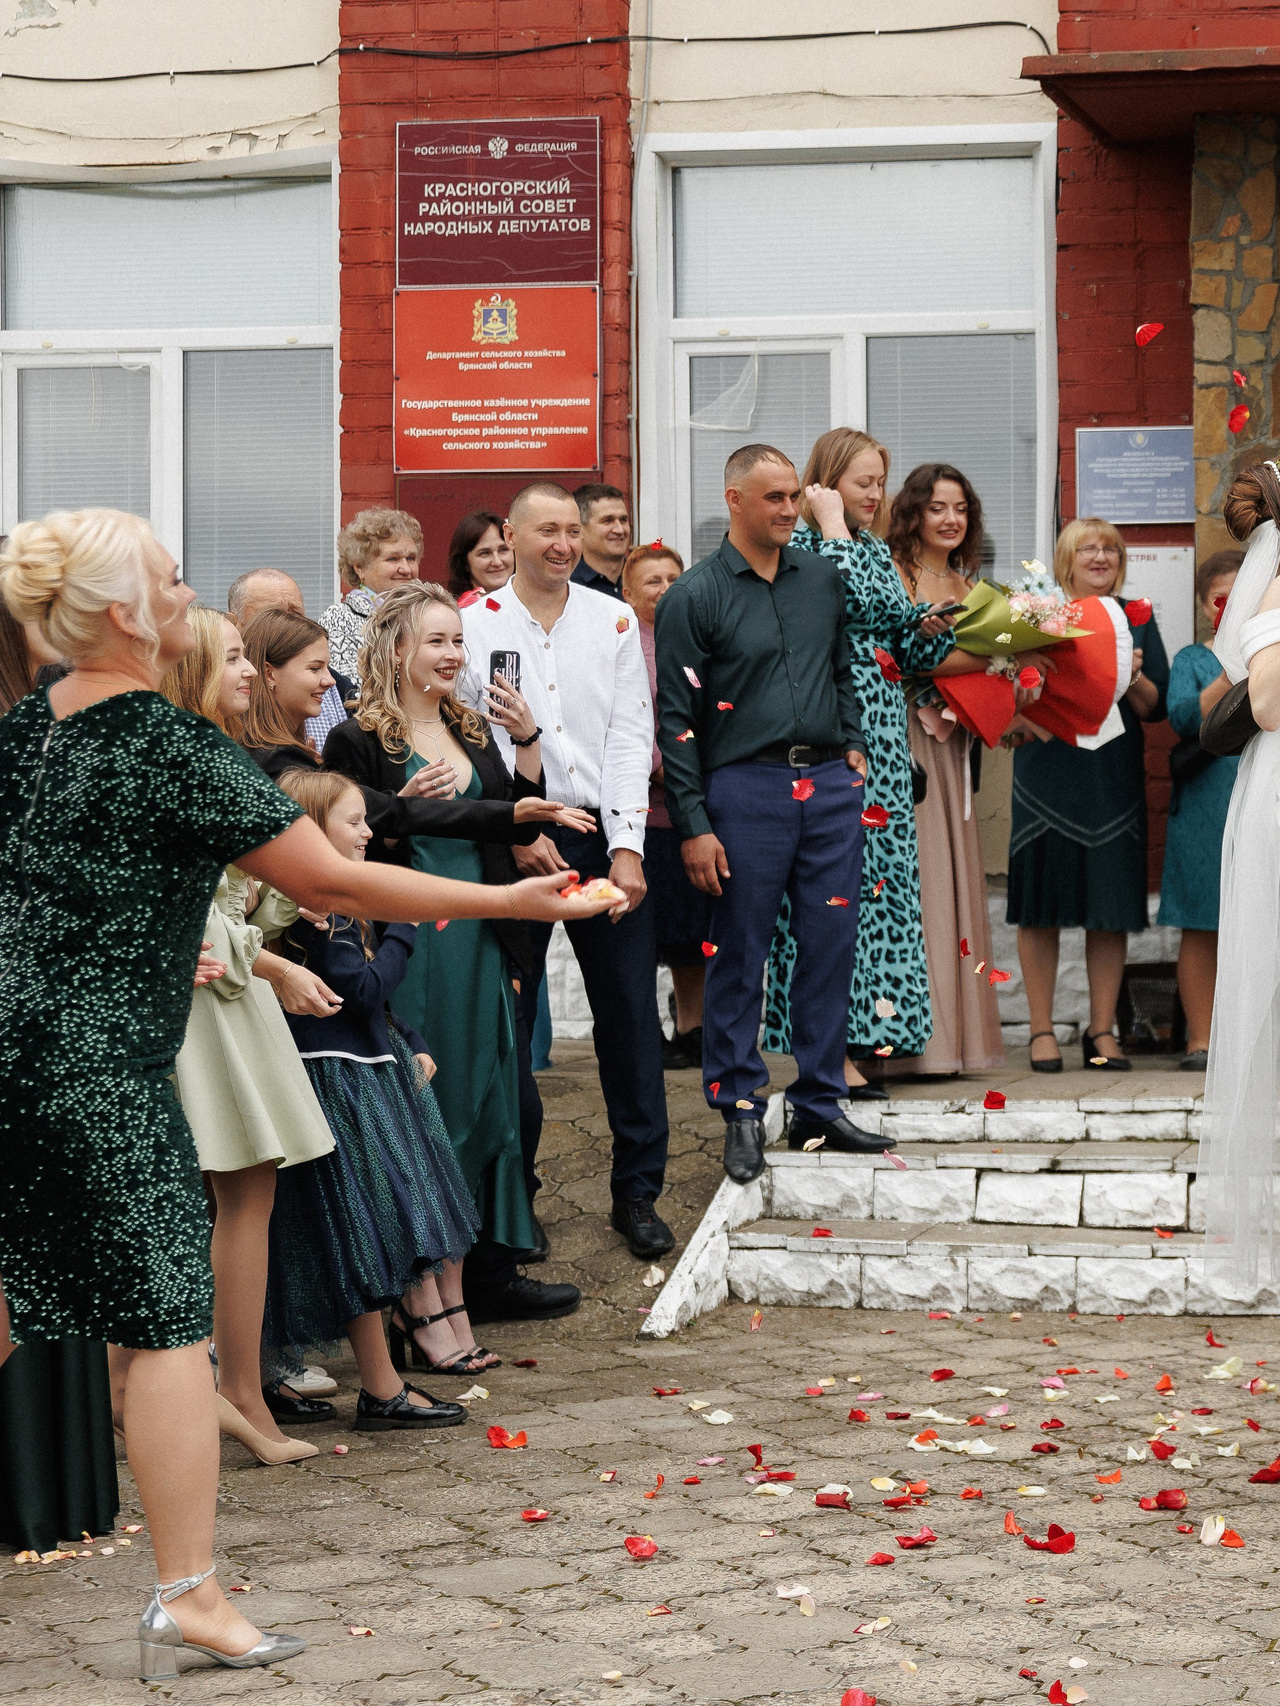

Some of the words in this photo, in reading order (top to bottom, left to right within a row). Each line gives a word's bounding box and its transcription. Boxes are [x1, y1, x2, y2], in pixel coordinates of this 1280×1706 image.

[414, 144, 482, 156] РОССИЙСКАЯ
[515, 142, 578, 153] ФЕДЕРАЦИЯ
[424, 177, 571, 198] КРАСНОГОРСКИЙ
[418, 198, 514, 216] РАЙОННЫЙ
[519, 199, 577, 214] СОВЕТ
[404, 220, 493, 237] НАРОДНЫХ
[497, 218, 591, 235] ДЕПУТАТОВ
[426, 351, 479, 361] Департамент
[481, 350, 522, 359] сельского
[523, 349, 566, 358] хозяйства
[458, 361, 498, 372] Брянской
[499, 361, 533, 370] области
[401, 398, 482, 410] Государственное
[484, 397, 529, 408] казённое
[530, 397, 591, 409] учреждение
[452, 411, 497, 423] Брянской
[499, 411, 539, 421] области
[403, 427, 481, 438] «Красногорское
[482, 426, 529, 437] районное
[530, 425, 589, 437] управление
[442, 440, 490, 451] сельского
[492, 439, 547, 451] хозяйства»
